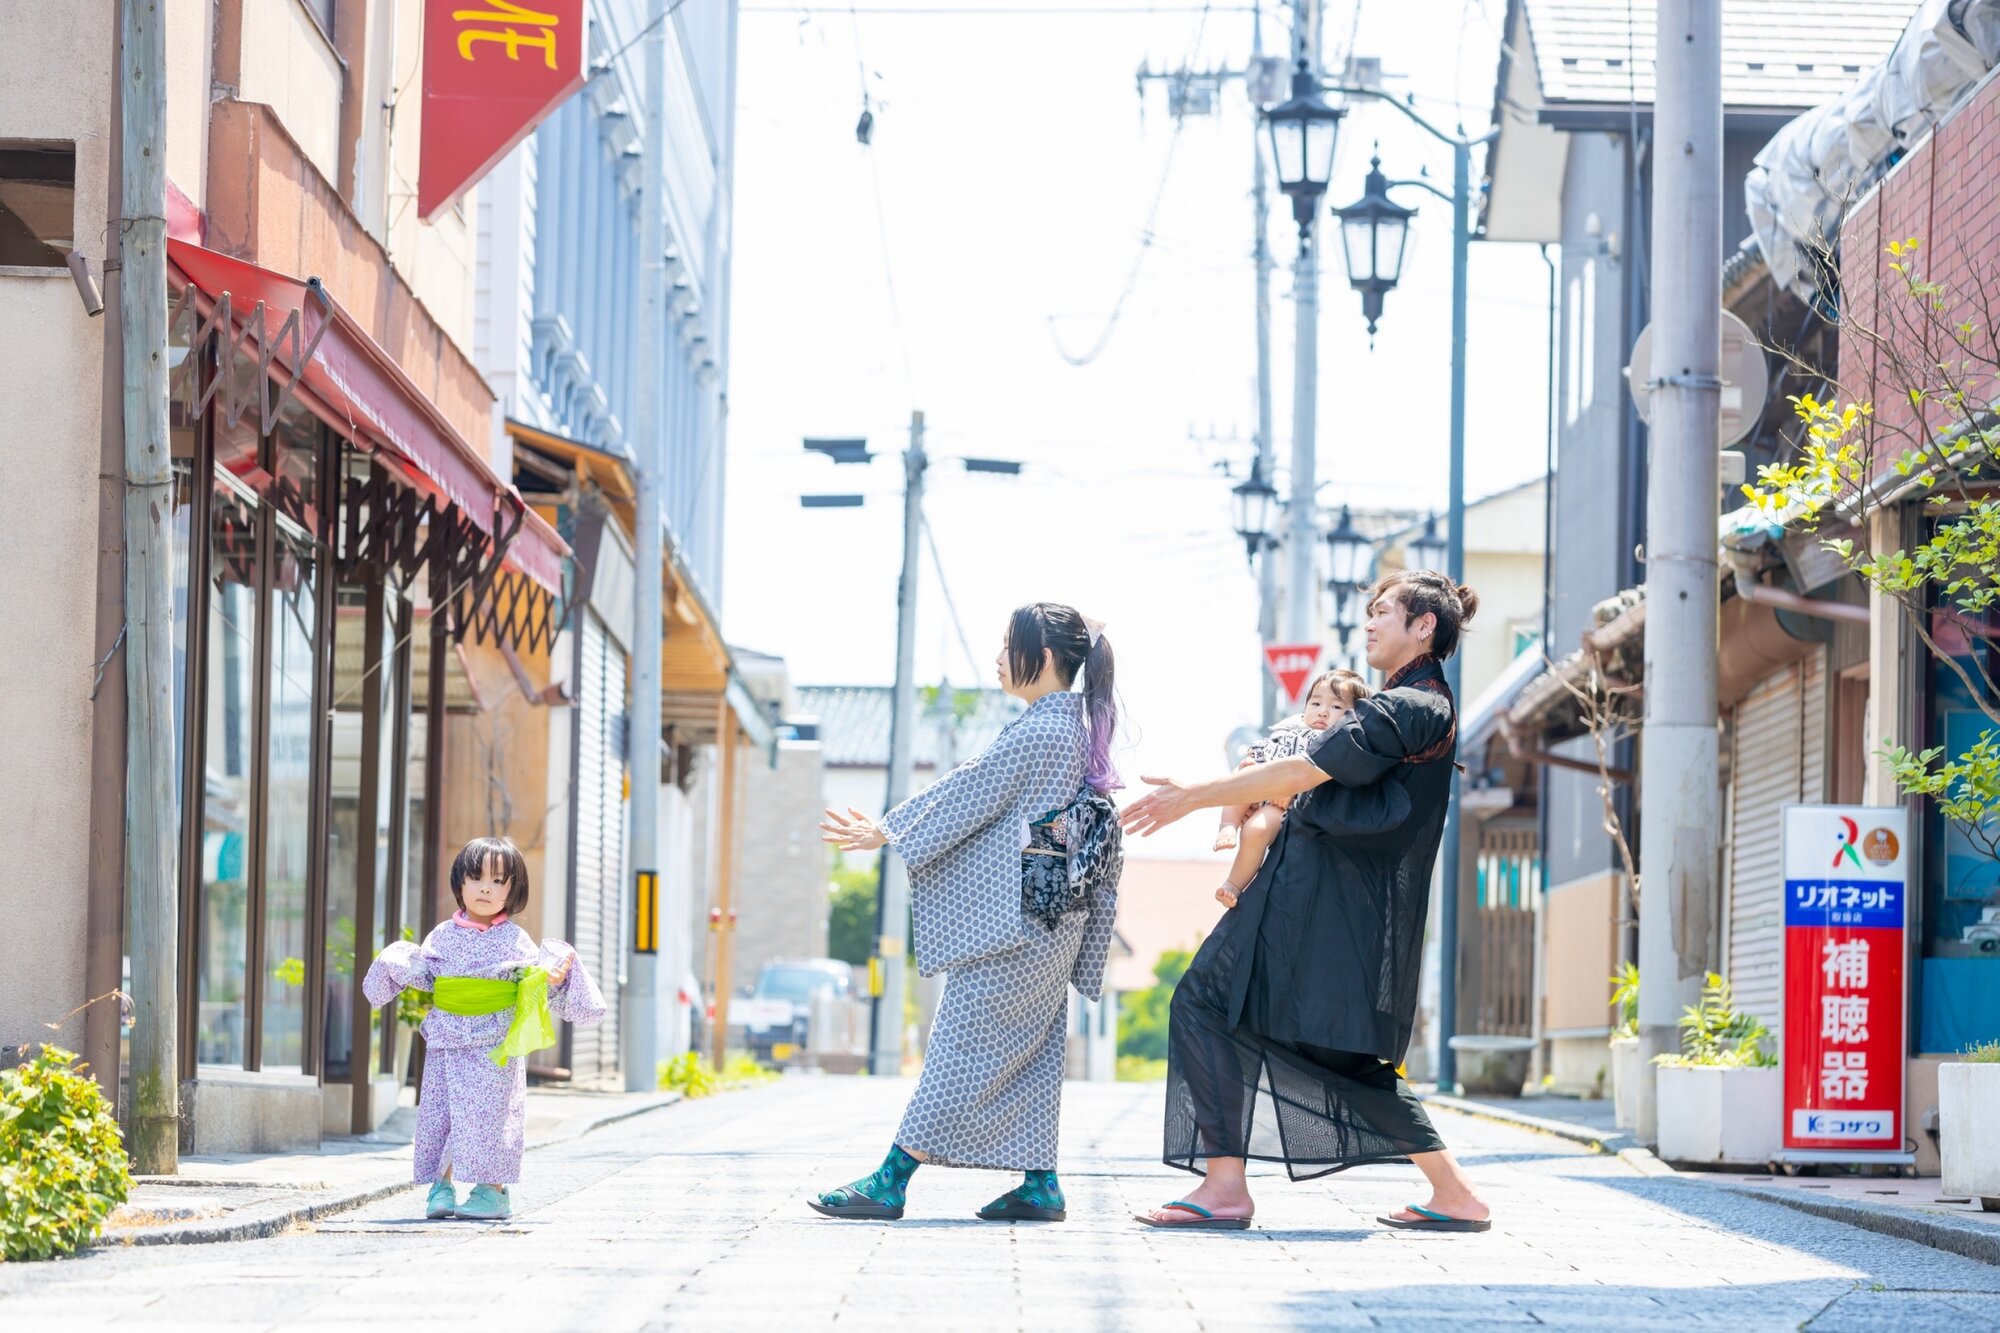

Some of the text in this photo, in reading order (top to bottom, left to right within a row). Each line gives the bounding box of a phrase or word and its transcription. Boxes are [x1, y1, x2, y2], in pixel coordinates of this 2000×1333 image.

[1796, 886, 1895, 909] リオネット
[1821, 938, 1870, 1100] 補聴器
